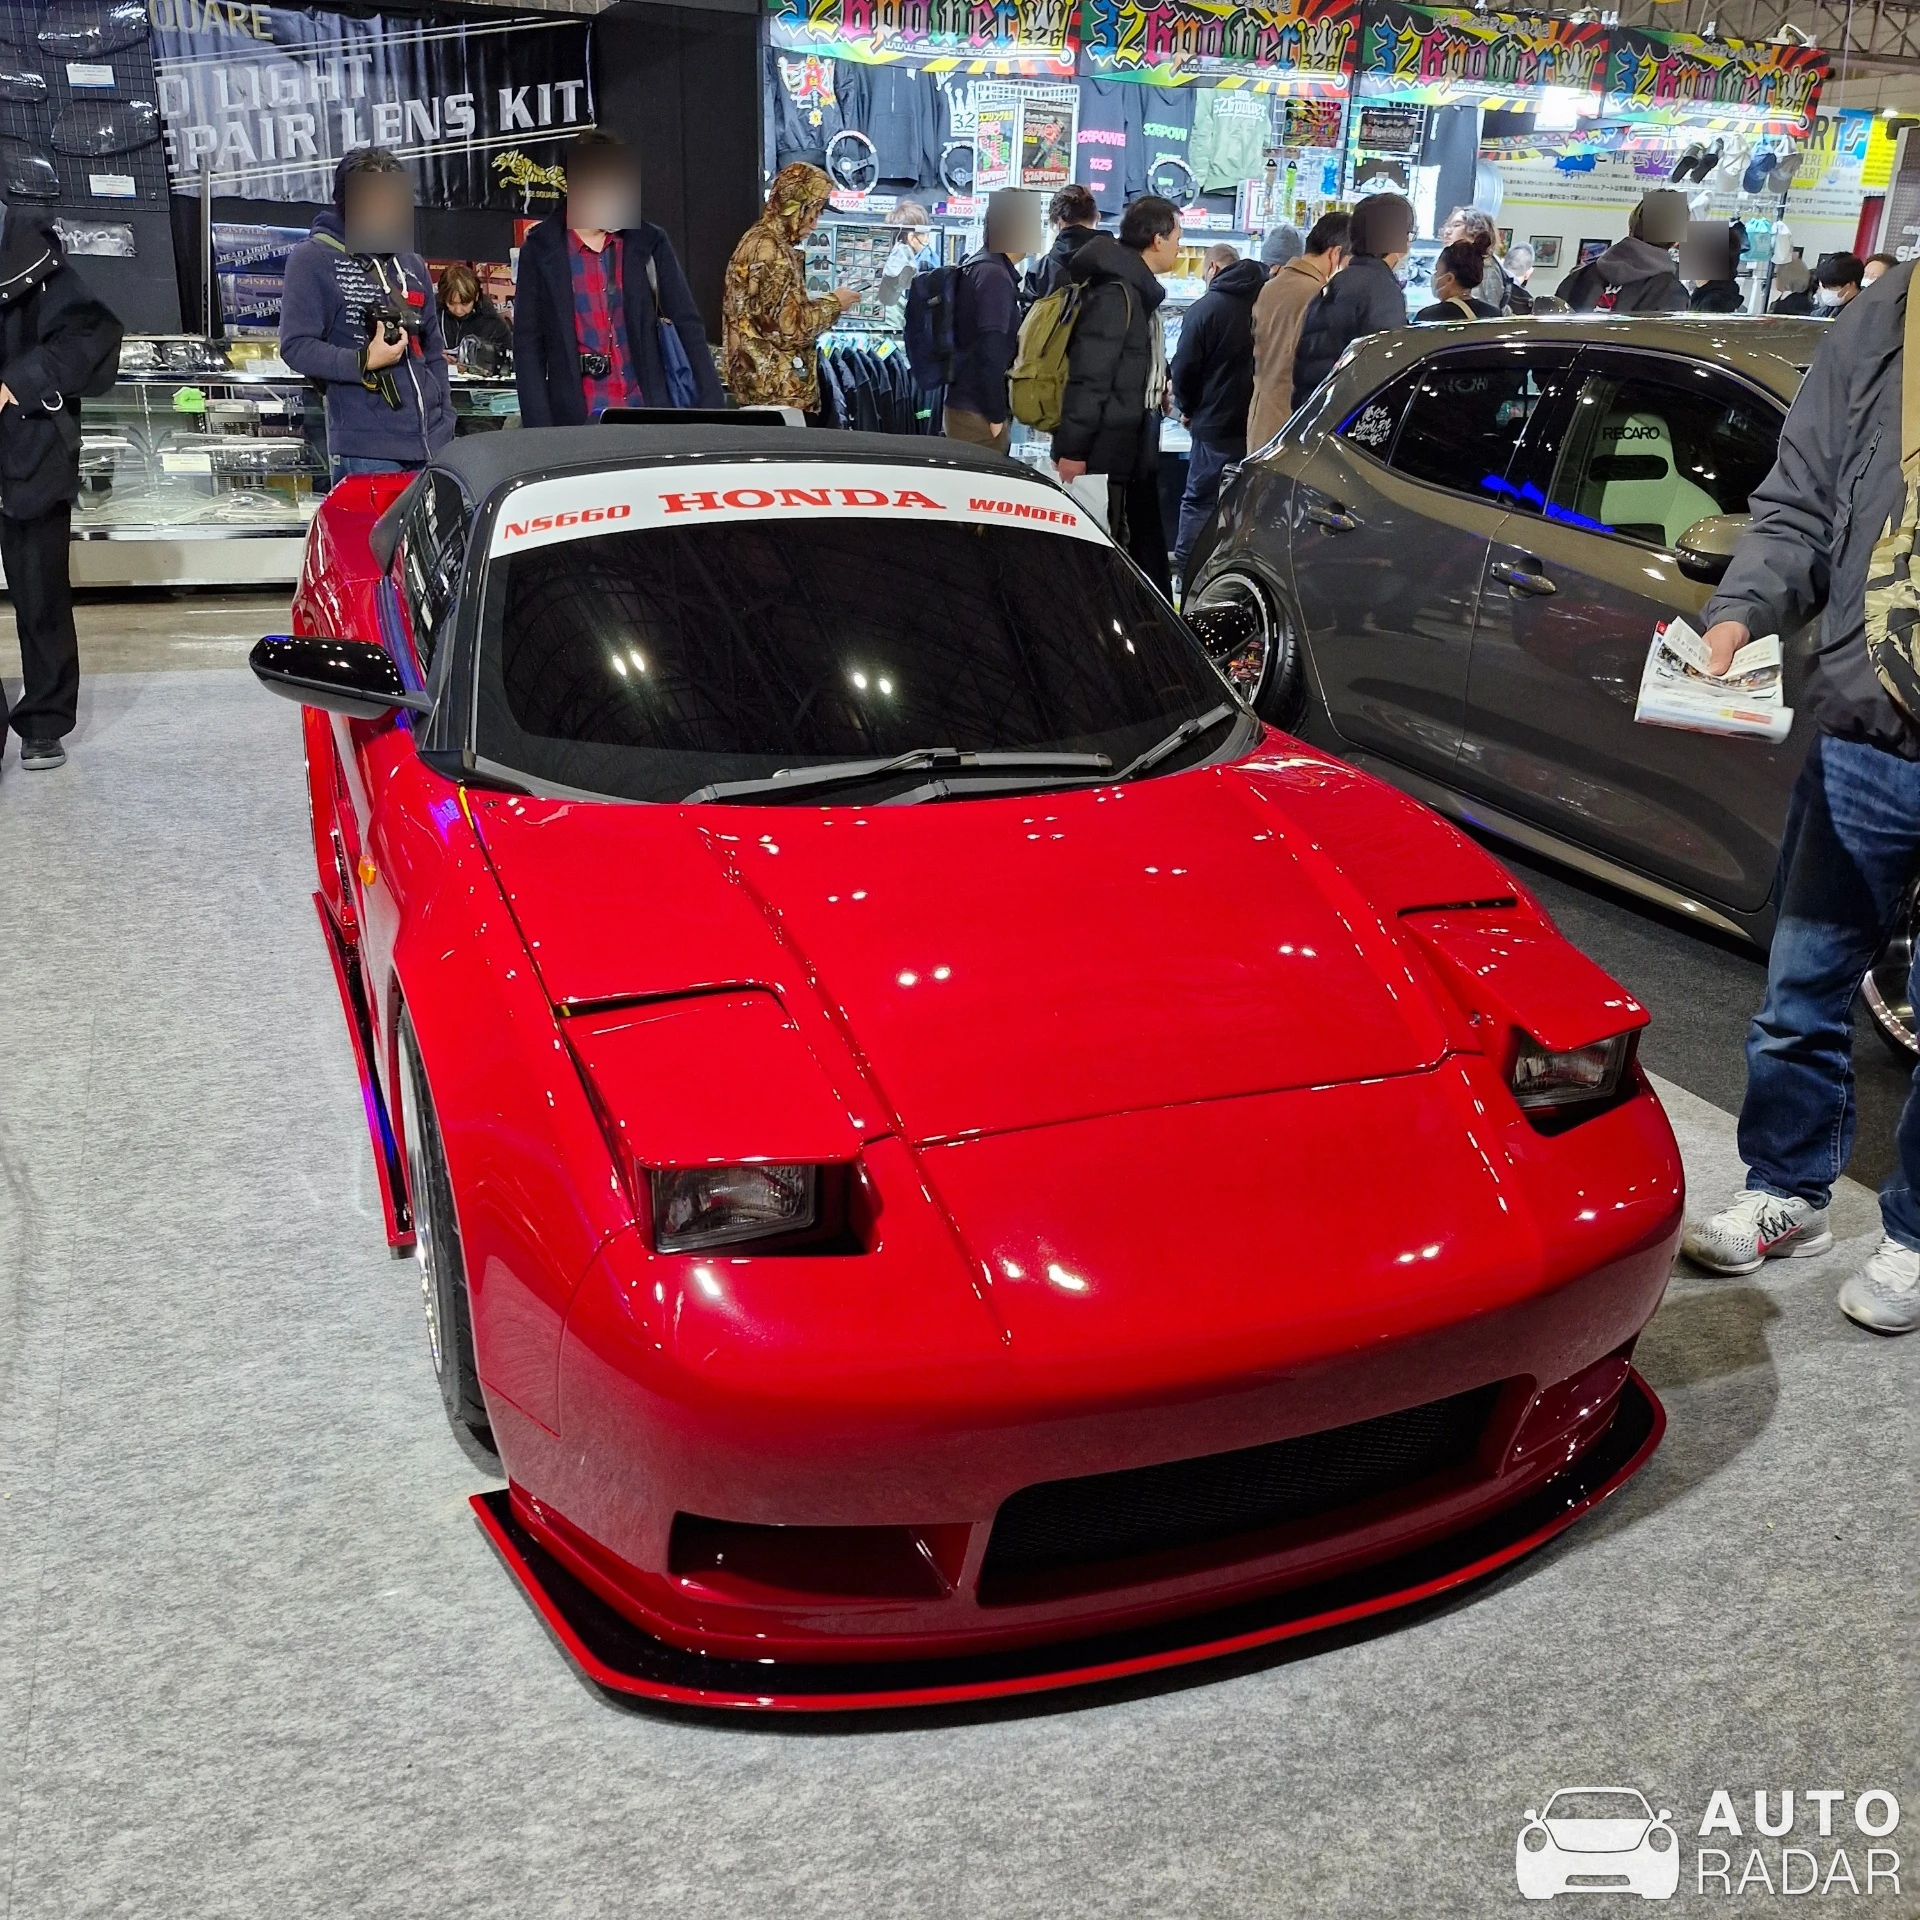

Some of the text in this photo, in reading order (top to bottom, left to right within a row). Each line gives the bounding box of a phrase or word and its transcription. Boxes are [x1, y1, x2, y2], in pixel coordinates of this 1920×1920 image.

[150, 0, 274, 40] QUARE
[1022, 28, 1064, 46] 326
[1089, 0, 1300, 75] 326power
[1302, 54, 1338, 71] 326
[1371, 26, 1553, 92] 326power
[212, 54, 372, 115] LIGHT
[1612, 50, 1776, 112] 326power
[341, 93, 476, 153] LENS
[498, 79, 584, 131] KIT
[1774, 97, 1807, 113] 326
[219, 250, 245, 262] HEAD
[235, 252, 270, 267] REPAIR
[241, 301, 265, 314] HEAD
[1602, 426, 1660, 440] RECARO
[504, 488, 1077, 540] NS660 HONDA WONDER
